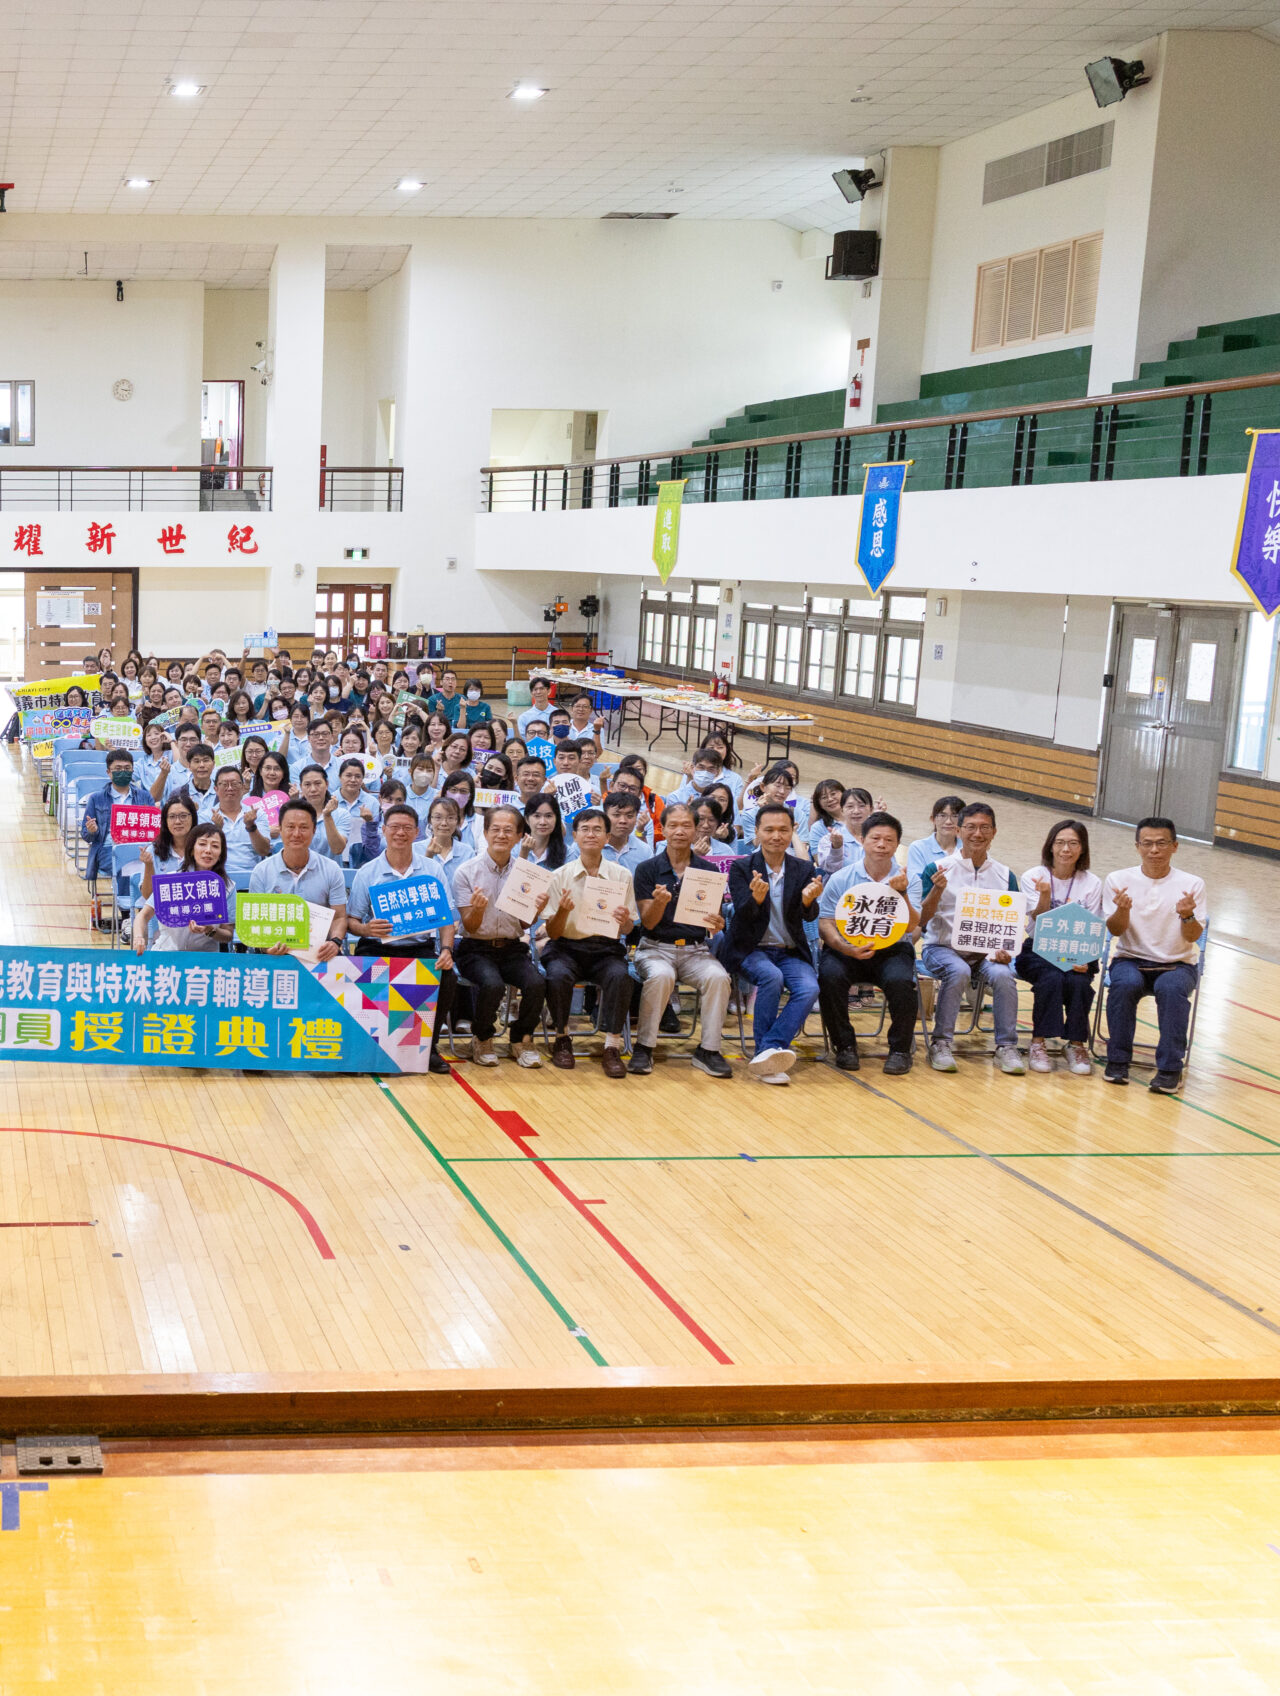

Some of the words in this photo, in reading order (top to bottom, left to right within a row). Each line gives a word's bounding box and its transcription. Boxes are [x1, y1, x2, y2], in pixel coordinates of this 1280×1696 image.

[870, 498, 887, 558] 感恩
[528, 745, 552, 758] 科技
[116, 811, 161, 828] 數學領域
[159, 879, 220, 902] 國語文領域
[377, 881, 441, 913] 自然科學領域
[960, 892, 991, 906] 打造
[243, 902, 304, 922] 健康與體育領域
[851, 895, 899, 916] 永續
[960, 906, 1019, 923] 學校特色
[846, 915, 894, 936] 教育
[959, 919, 1018, 937] 展現校本
[1040, 917, 1103, 937] 戶外教育
[957, 934, 1016, 952] 課程能量
[1037, 937, 1100, 956] 海洋教育中心
[69, 1010, 344, 1060] 授證典禮
